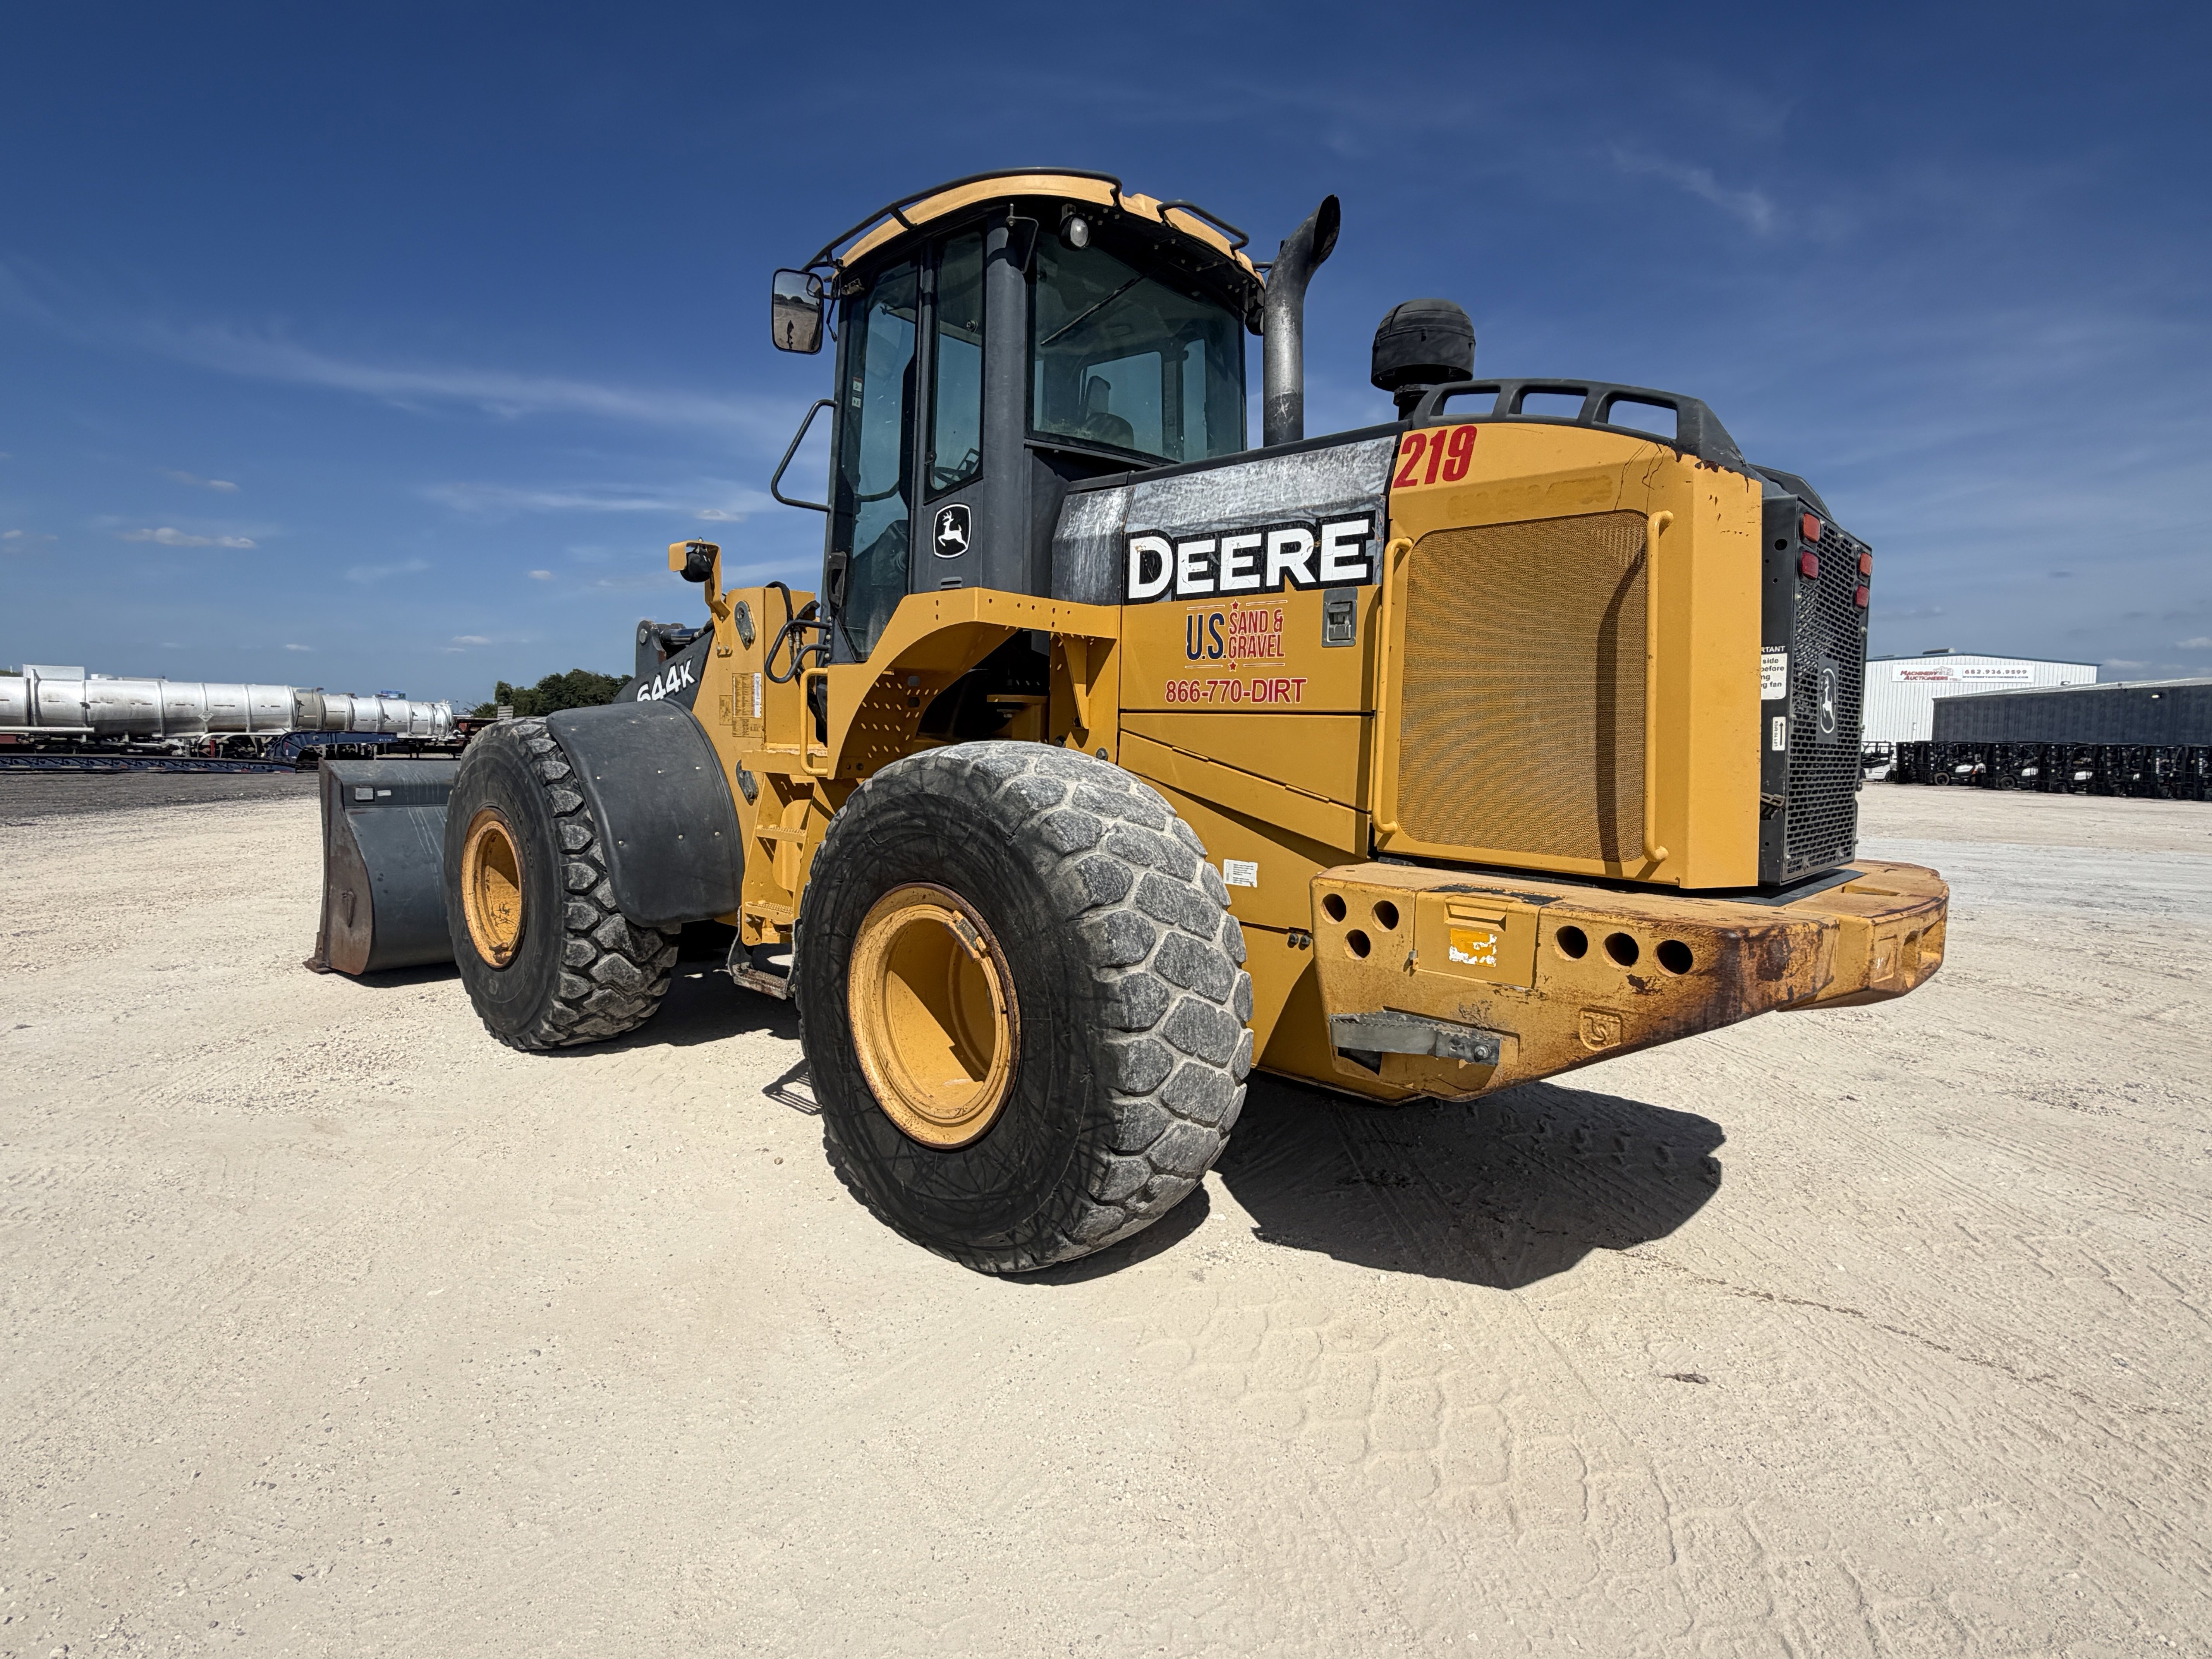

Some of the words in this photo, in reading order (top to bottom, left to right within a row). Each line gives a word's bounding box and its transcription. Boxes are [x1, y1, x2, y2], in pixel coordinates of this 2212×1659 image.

[1393, 426, 1477, 489] 219
[1128, 519, 1370, 599] DEERE
[1187, 612, 1227, 660] U.S.
[1228, 610, 1269, 635] SAND
[1273, 608, 1283, 633] &
[1228, 634, 1285, 659] GRAVEL
[637, 659, 695, 702] 644K
[1166, 678, 1307, 704] 866-770-DIRT
